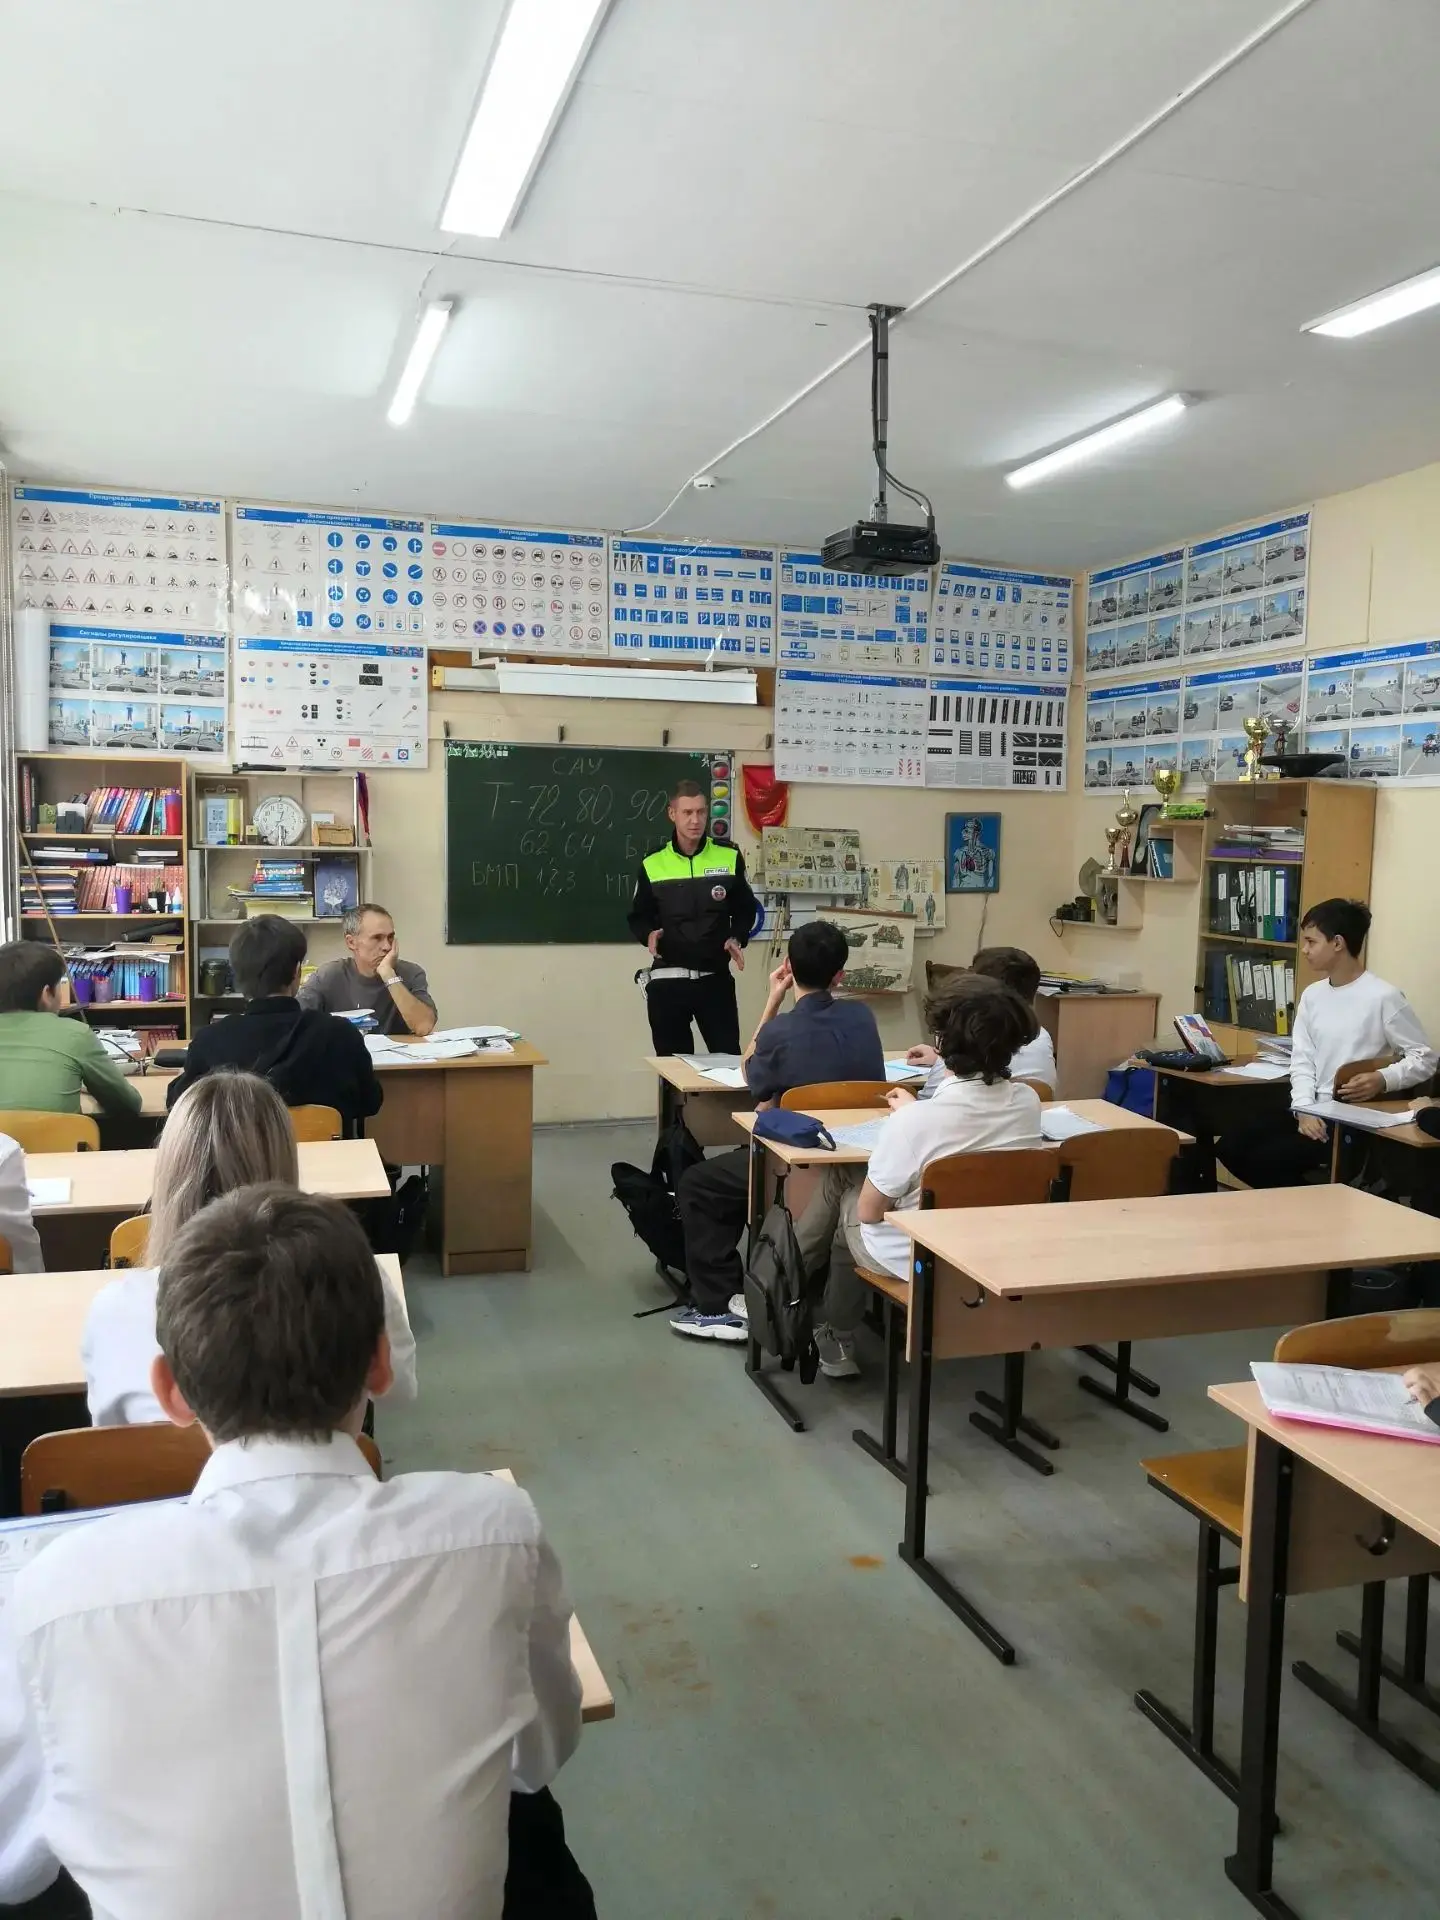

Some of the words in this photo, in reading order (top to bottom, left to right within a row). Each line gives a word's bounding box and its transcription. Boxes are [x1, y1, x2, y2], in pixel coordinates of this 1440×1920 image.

[552, 756, 603, 776] САУ
[627, 789, 668, 821] 90
[472, 861, 519, 889] БМП
